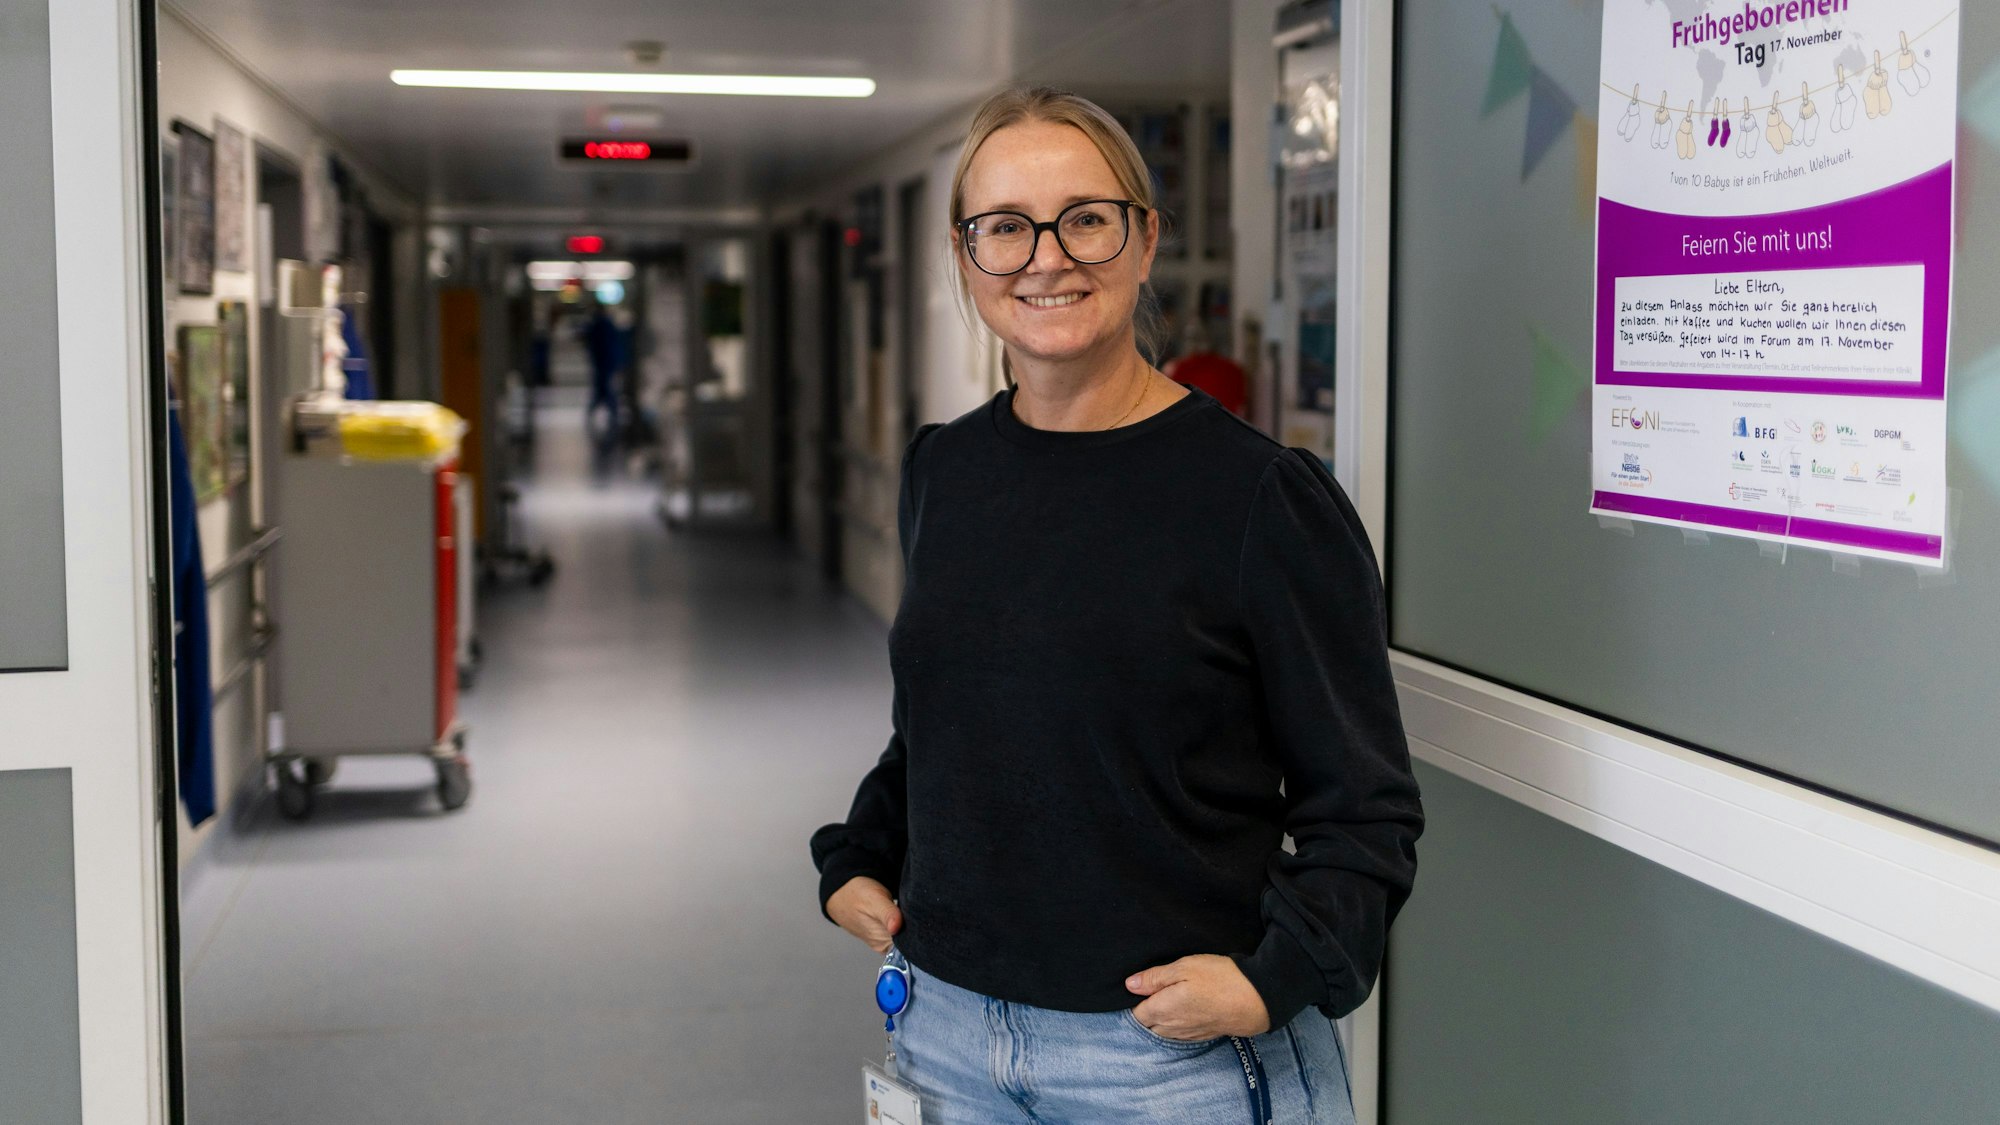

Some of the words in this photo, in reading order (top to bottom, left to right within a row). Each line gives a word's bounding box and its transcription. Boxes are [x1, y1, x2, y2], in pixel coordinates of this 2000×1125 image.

[1735, 42, 1766, 68] Tag
[1770, 40, 1784, 52] 17.
[1787, 29, 1842, 50] November
[1674, 176, 1688, 186] von
[1692, 174, 1701, 187] 10
[1704, 175, 1730, 192] Babys
[1733, 176, 1744, 188] ist
[1747, 174, 1760, 186] ein
[1809, 148, 1854, 172] Weltweit.
[1682, 234, 1729, 256] Feiern
[1733, 230, 1757, 254] Sie
[1762, 228, 1790, 252] mit
[1795, 224, 1832, 251] uns!
[1714, 278, 1740, 295] Liebe
[1746, 279, 1784, 294] Eltern,
[1635, 300, 1664, 311] diesem
[1670, 299, 1703, 312] Anlass
[1708, 300, 1749, 312] möchten
[1754, 303, 1774, 312] wir
[1781, 300, 1797, 312] Sie
[1802, 302, 1830, 316] ganz
[1832, 300, 1878, 314] herzlich
[1620, 316, 1660, 327] einladen.
[1664, 316, 1679, 326] Mit
[1716, 316, 1734, 327] und
[1776, 318, 1807, 330] wollen
[1812, 320, 1830, 330] wir
[1836, 320, 1867, 332] Ihnen
[1870, 319, 1906, 332] diesen
[1620, 330, 1634, 345] Tag
[1636, 330, 1676, 345] versüßen.
[1717, 335, 1738, 344] wird
[1744, 336, 1754, 344] im
[1760, 334, 1791, 346] Forum
[1798, 336, 1814, 346] am
[1820, 336, 1833, 347] 17.
[1838, 336, 1894, 350] November
[1700, 350, 1717, 359] von
[1755, 349, 1765, 360] h
[1874, 429, 1901, 440] DGPGM
